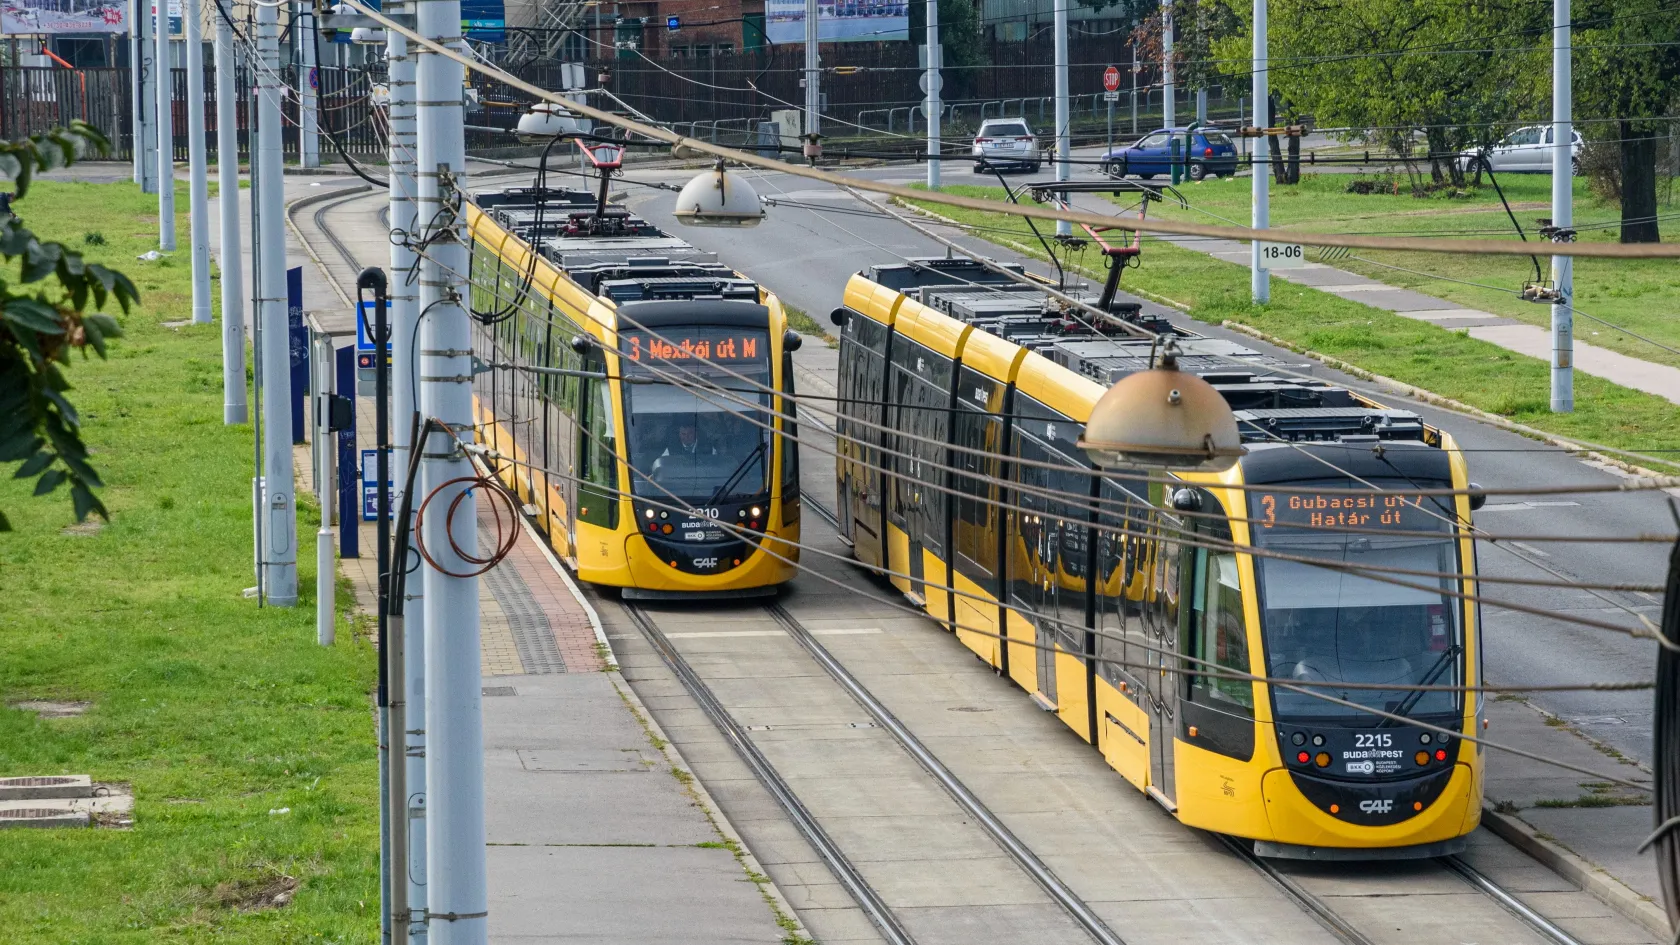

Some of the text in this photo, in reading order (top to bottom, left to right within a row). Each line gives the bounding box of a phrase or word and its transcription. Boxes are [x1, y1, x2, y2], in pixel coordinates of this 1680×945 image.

[1106, 73, 1118, 86] STOP
[1263, 245, 1301, 258] 18-06
[629, 336, 756, 361] 3 Mexikói út M
[1289, 494, 1375, 509] Gubacsi
[1261, 495, 1276, 528] 3
[1311, 509, 1401, 526] Határ út
[693, 558, 718, 568] CAF
[1355, 733, 1392, 747] 2215
[1359, 800, 1393, 814] CAF
